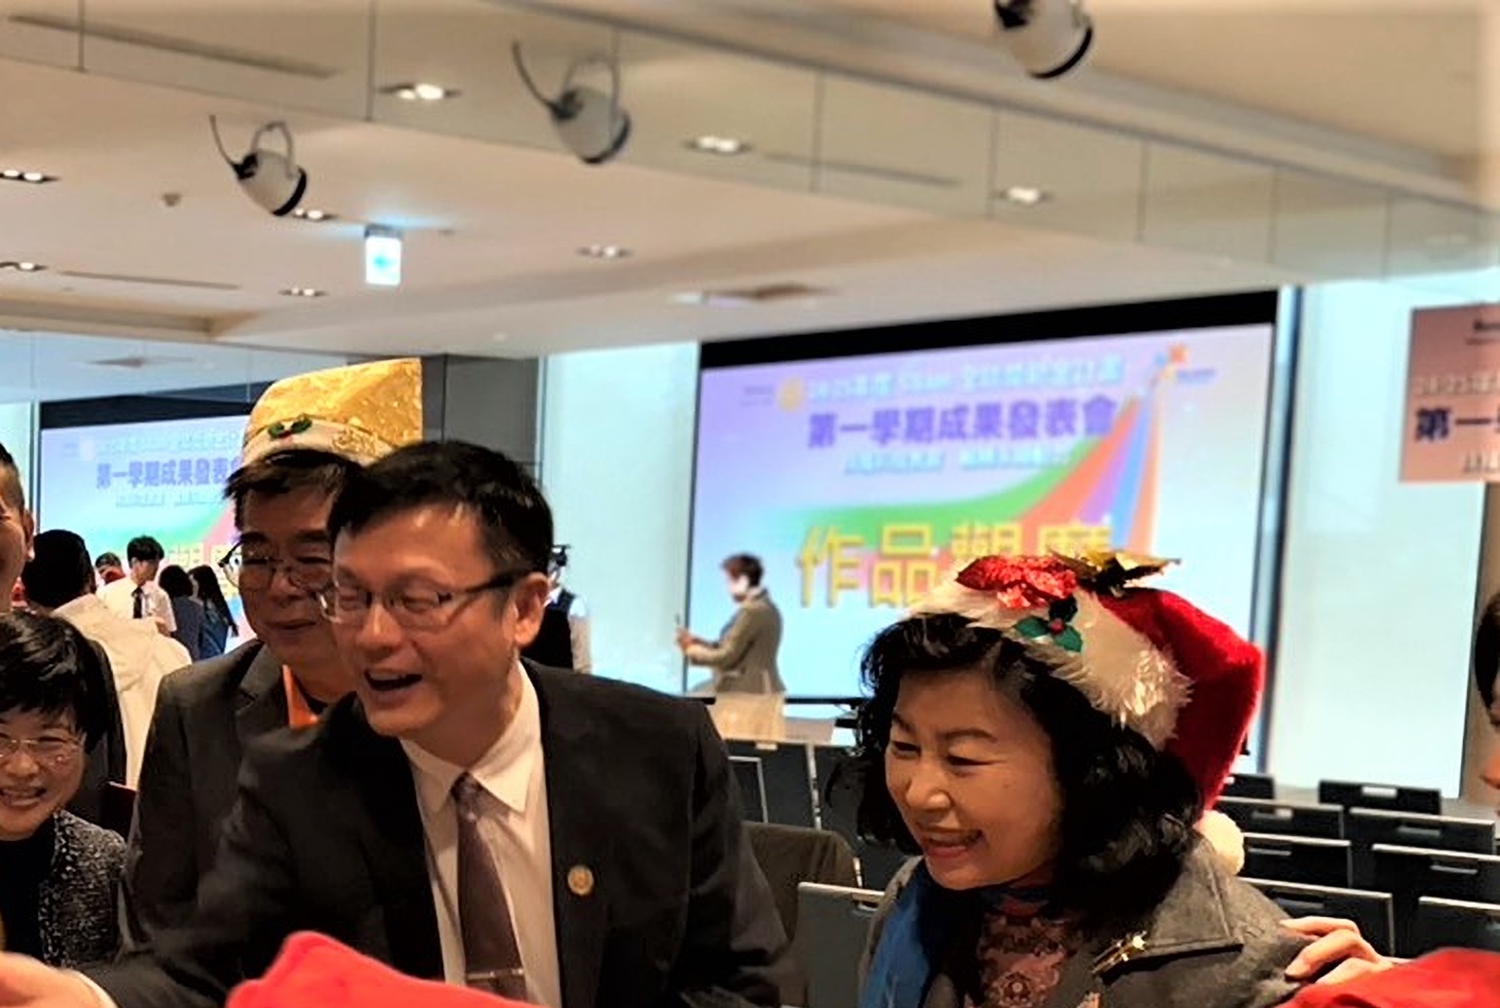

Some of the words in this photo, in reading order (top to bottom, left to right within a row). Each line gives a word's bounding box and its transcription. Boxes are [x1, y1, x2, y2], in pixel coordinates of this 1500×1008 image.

[807, 394, 1118, 449] 第一學期成果發表會
